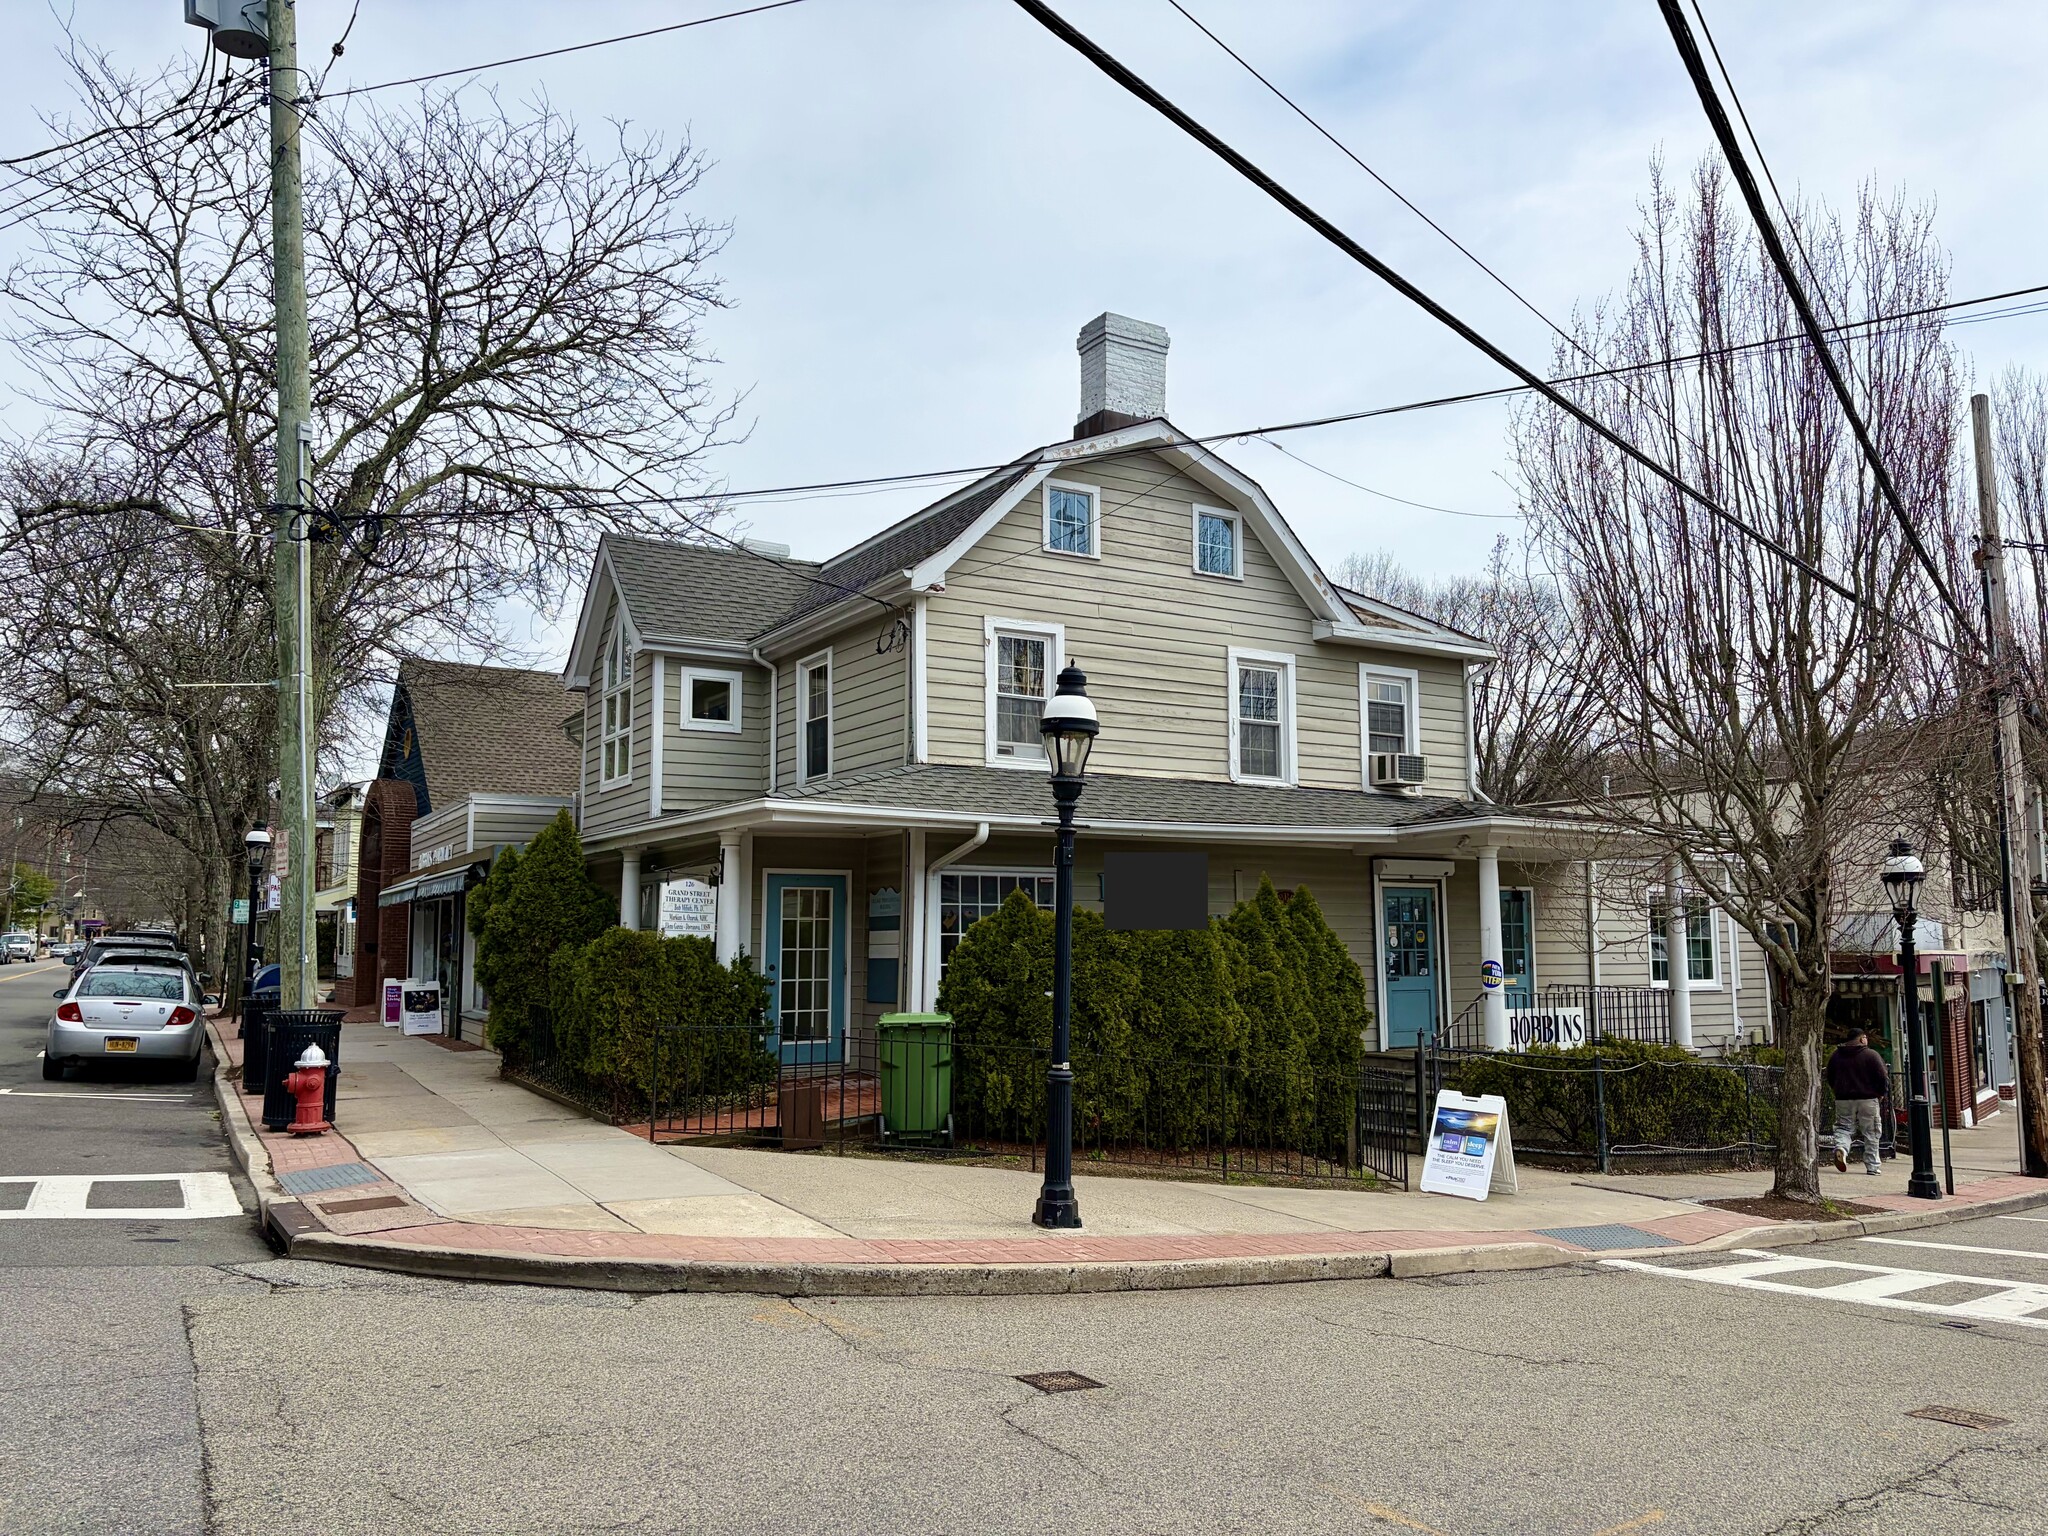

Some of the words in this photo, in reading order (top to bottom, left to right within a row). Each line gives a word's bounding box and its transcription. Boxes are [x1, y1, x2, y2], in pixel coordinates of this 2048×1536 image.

[689, 890, 711, 898] STREET
[665, 896, 691, 904] THERAPY
[691, 897, 714, 905] CENTER
[1510, 1014, 1582, 1045] ROBBINS
